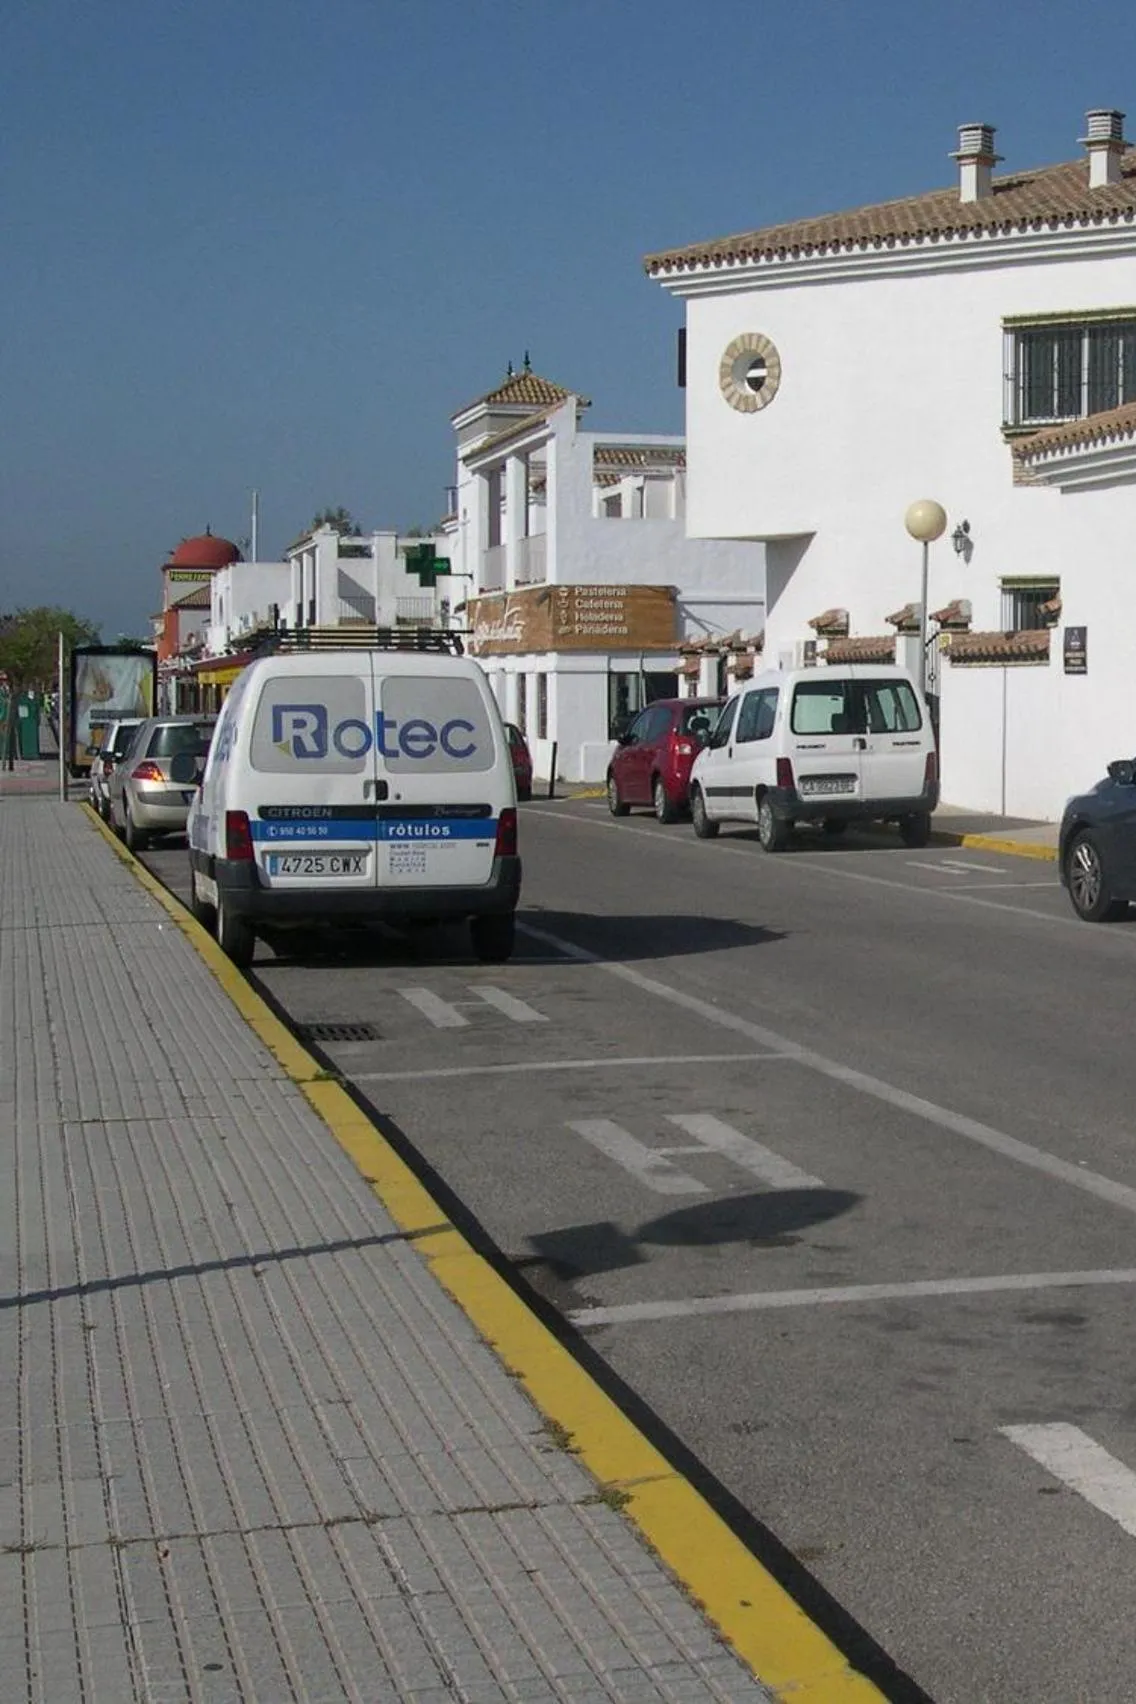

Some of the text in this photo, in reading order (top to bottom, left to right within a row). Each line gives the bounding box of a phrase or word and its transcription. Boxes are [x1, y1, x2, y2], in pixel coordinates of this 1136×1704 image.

[272, 704, 477, 759] Rotec
[388, 823, 451, 836] rótulos
[281, 857, 362, 873] 4725 CWX
